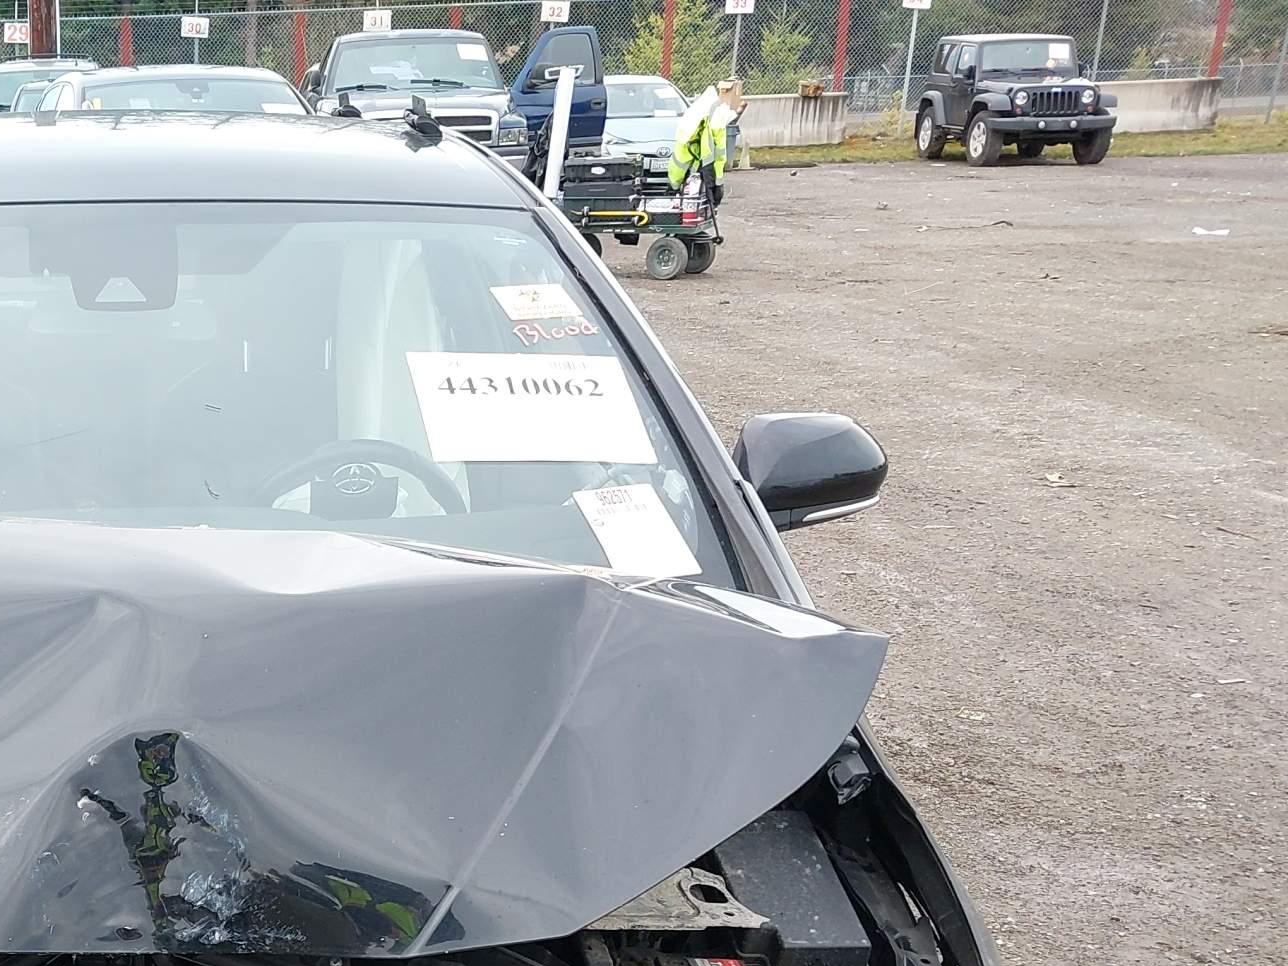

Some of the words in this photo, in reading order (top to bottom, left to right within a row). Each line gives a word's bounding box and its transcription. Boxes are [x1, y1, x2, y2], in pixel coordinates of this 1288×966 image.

[549, 7, 563, 17] 32
[187, 22, 202, 34] 30
[370, 15, 384, 27] 31
[7, 25, 29, 42] 29
[512, 321, 600, 346] Blood
[437, 376, 604, 397] 44310062
